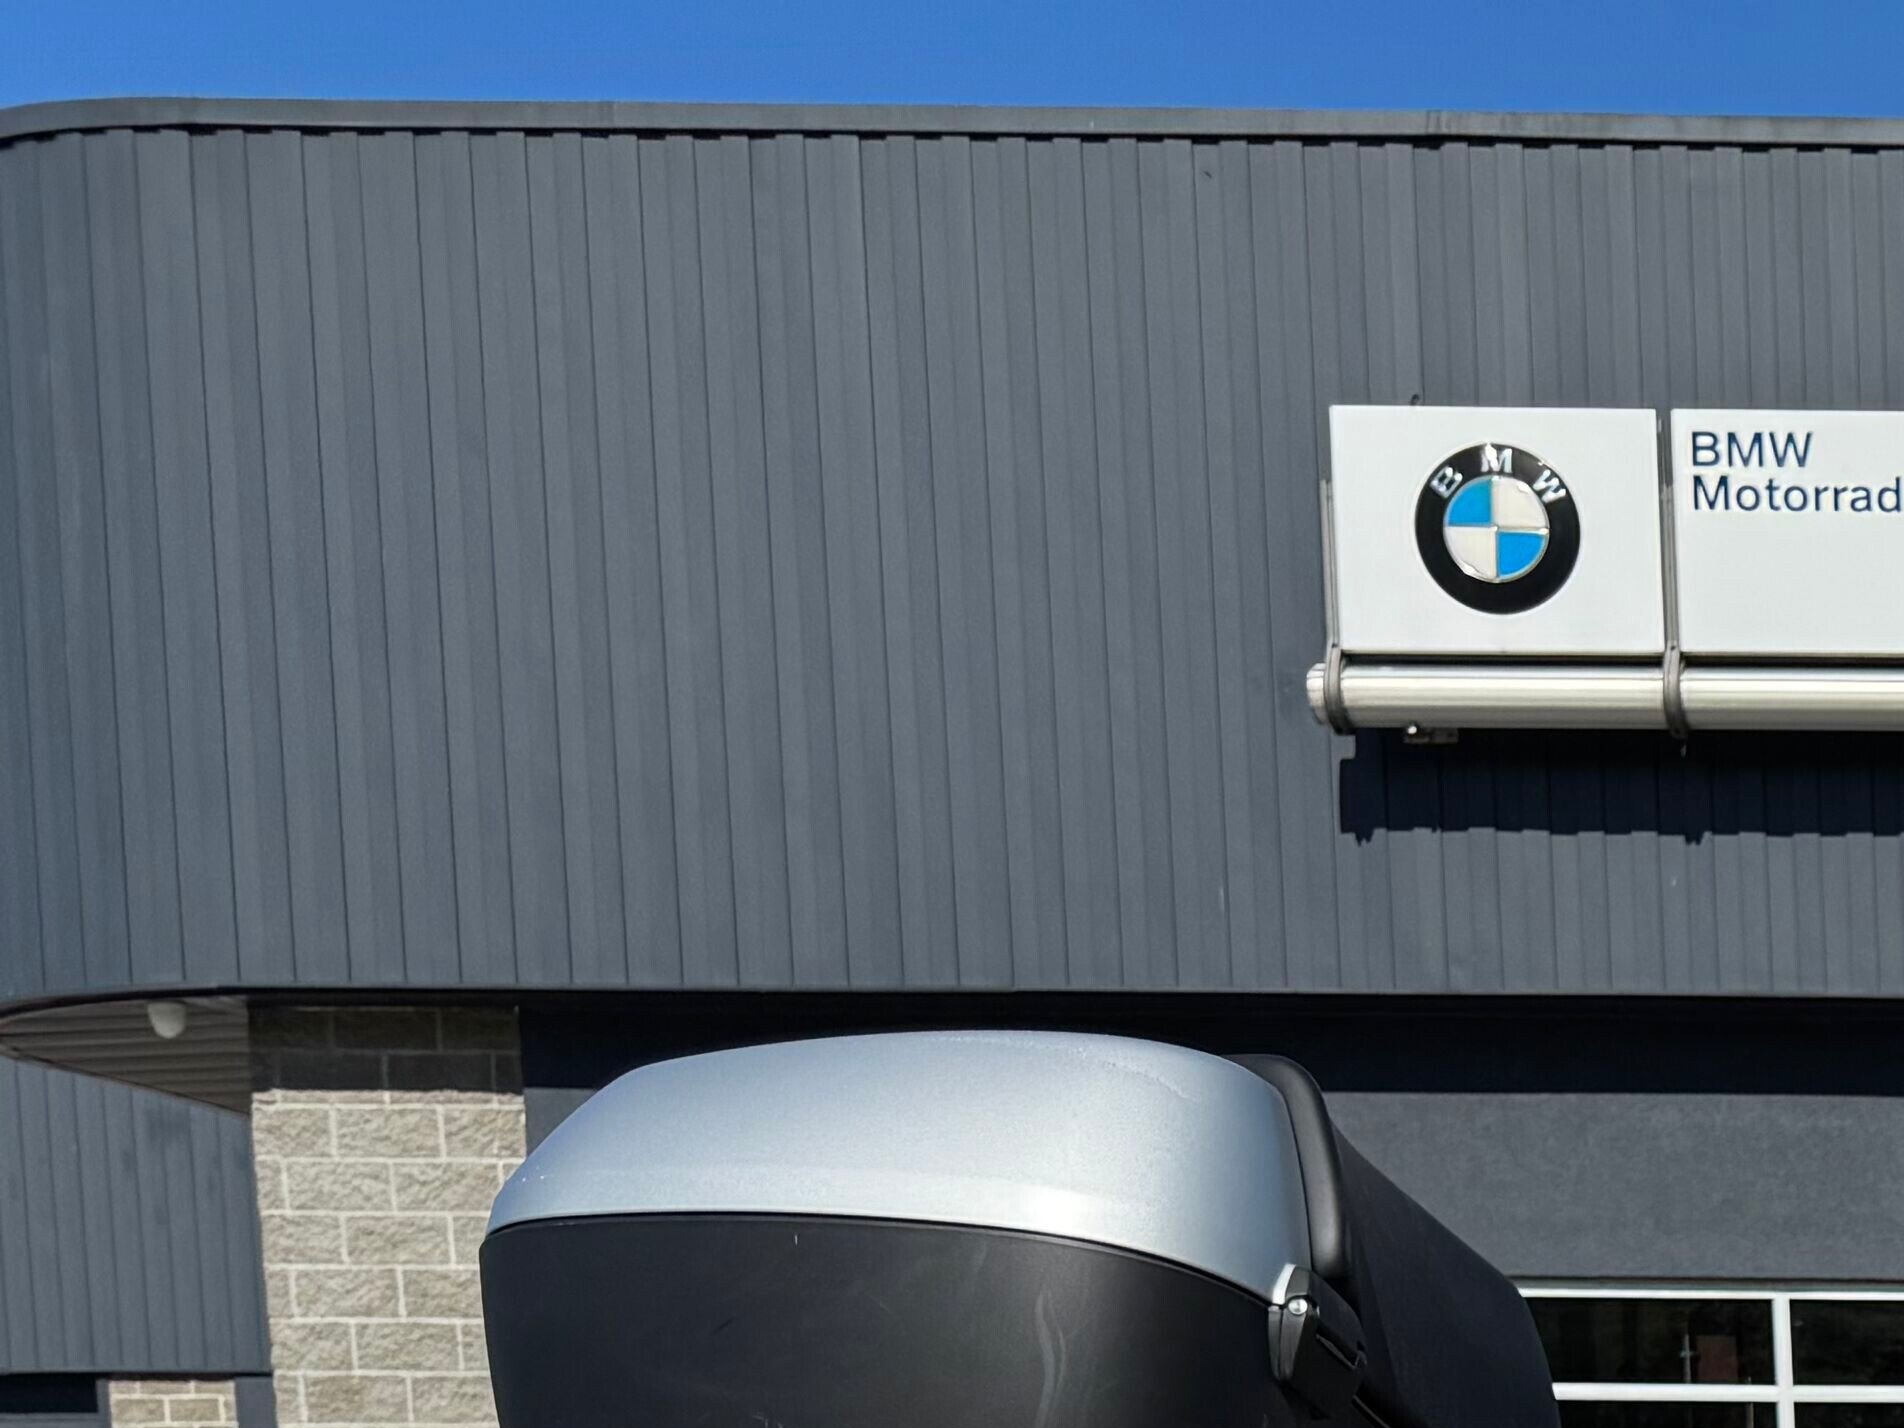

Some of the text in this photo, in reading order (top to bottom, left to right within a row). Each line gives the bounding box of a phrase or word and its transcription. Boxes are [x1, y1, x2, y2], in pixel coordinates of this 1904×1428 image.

[1691, 431, 1812, 467] BMW
[1430, 443, 1566, 503] BMW
[1692, 474, 1902, 512] Motorrad
